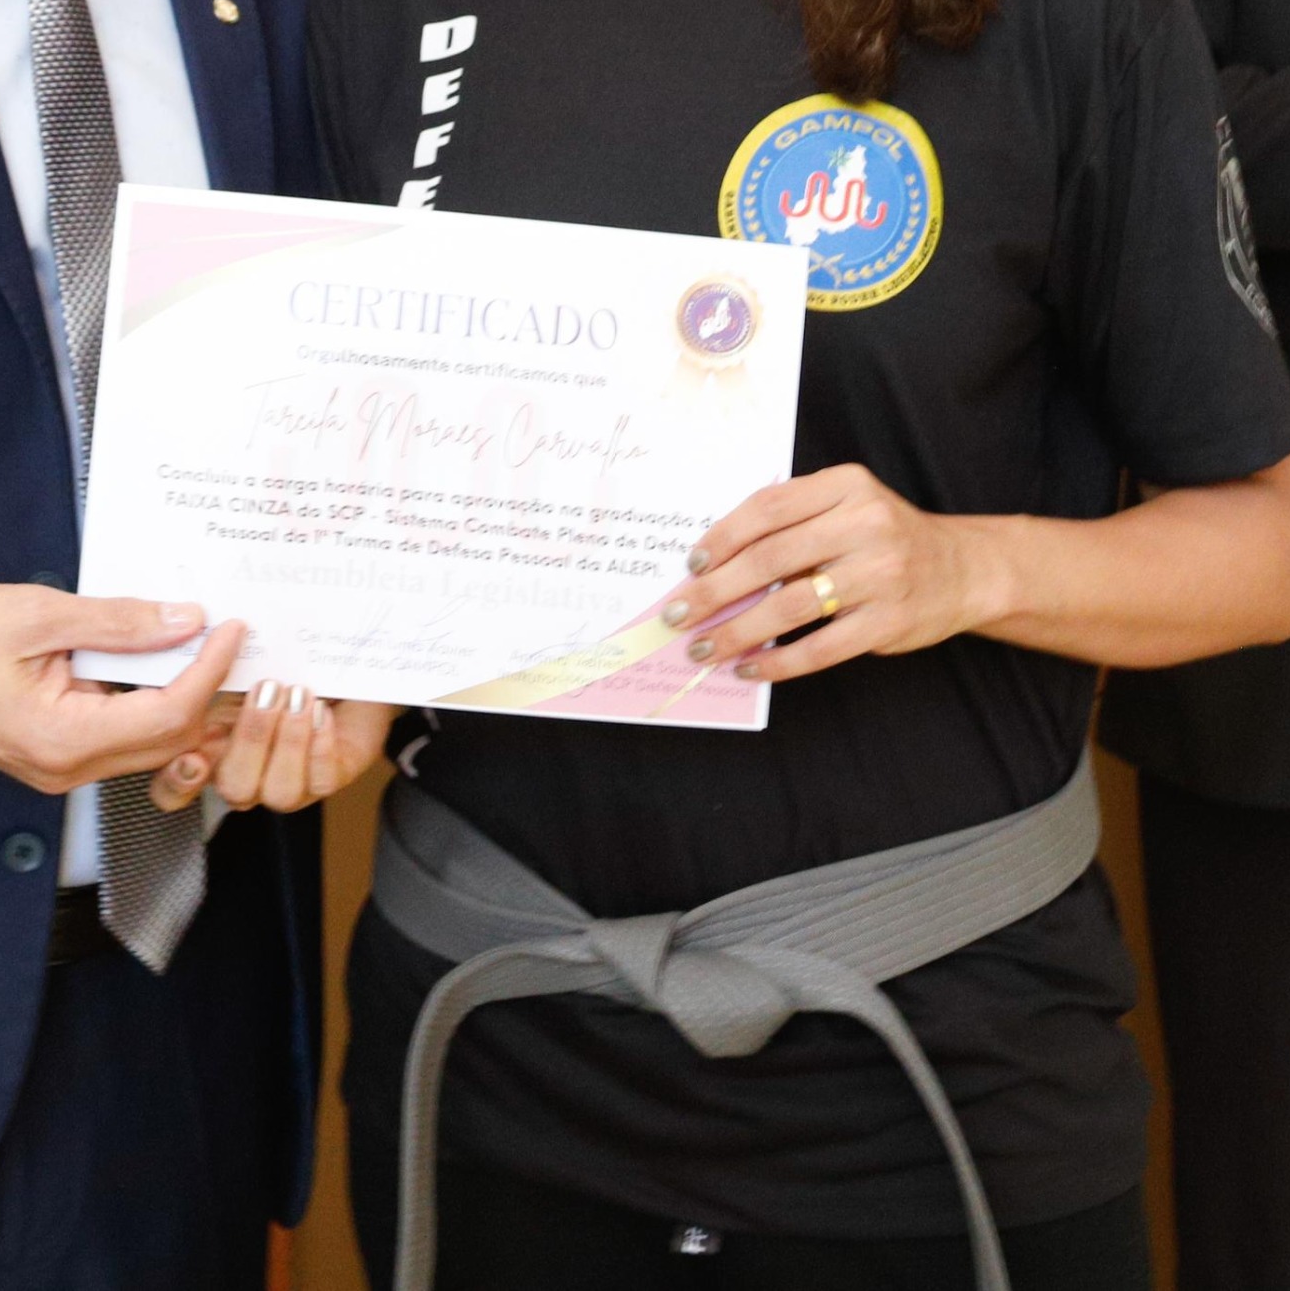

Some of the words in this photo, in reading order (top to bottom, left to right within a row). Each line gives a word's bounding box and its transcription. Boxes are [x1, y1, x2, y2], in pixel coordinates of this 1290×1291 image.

[774, 114, 902, 163] GAMPOL
[288, 280, 620, 351] CERTIFICADO
[296, 343, 451, 374] Orgulhosamente
[452, 361, 570, 386] certificamos
[572, 371, 609, 389] que
[157, 463, 240, 486] Concluiu
[261, 475, 319, 495] carga
[323, 477, 396, 498] horária
[399, 488, 445, 504] para
[449, 492, 555, 516] aprovação
[588, 505, 694, 530] graduação
[164, 491, 223, 511] FAIXA
[226, 497, 292, 518] CINZA
[326, 504, 367, 521] SCP
[384, 508, 459, 532] Sistema
[462, 517, 551, 540] Combate
[613, 533, 639, 550] de
[205, 521, 279, 543] Pessoal
[332, 530, 393, 552] Turma
[396, 538, 423, 553] de
[425, 539, 494, 561] Defesa
[497, 546, 574, 570] Pessoal
[228, 552, 426, 595] Assembleia
[436, 560, 627, 615] Legislativa
